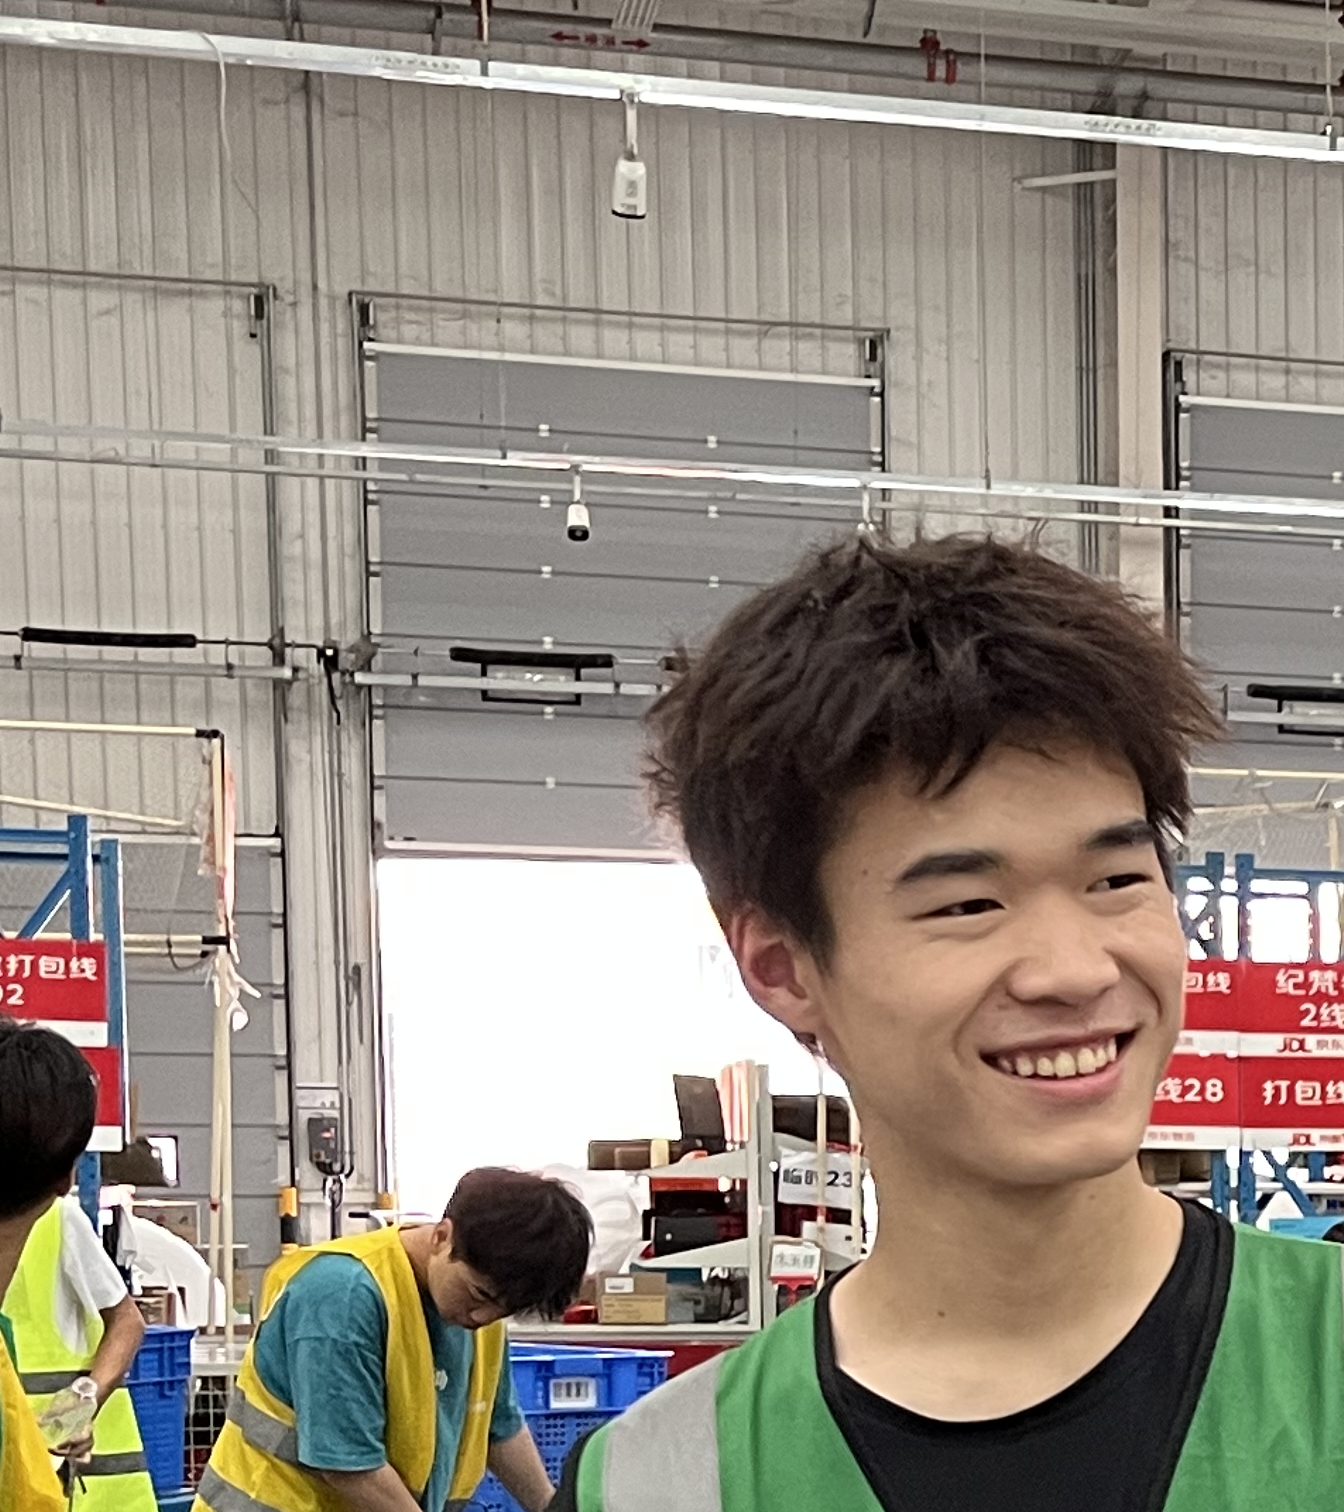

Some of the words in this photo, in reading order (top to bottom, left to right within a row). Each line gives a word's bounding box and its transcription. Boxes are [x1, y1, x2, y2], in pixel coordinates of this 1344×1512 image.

[0, 954, 98, 981] 打包线
[0, 983, 25, 1006] 2
[1277, 1036, 1312, 1053] JDL
